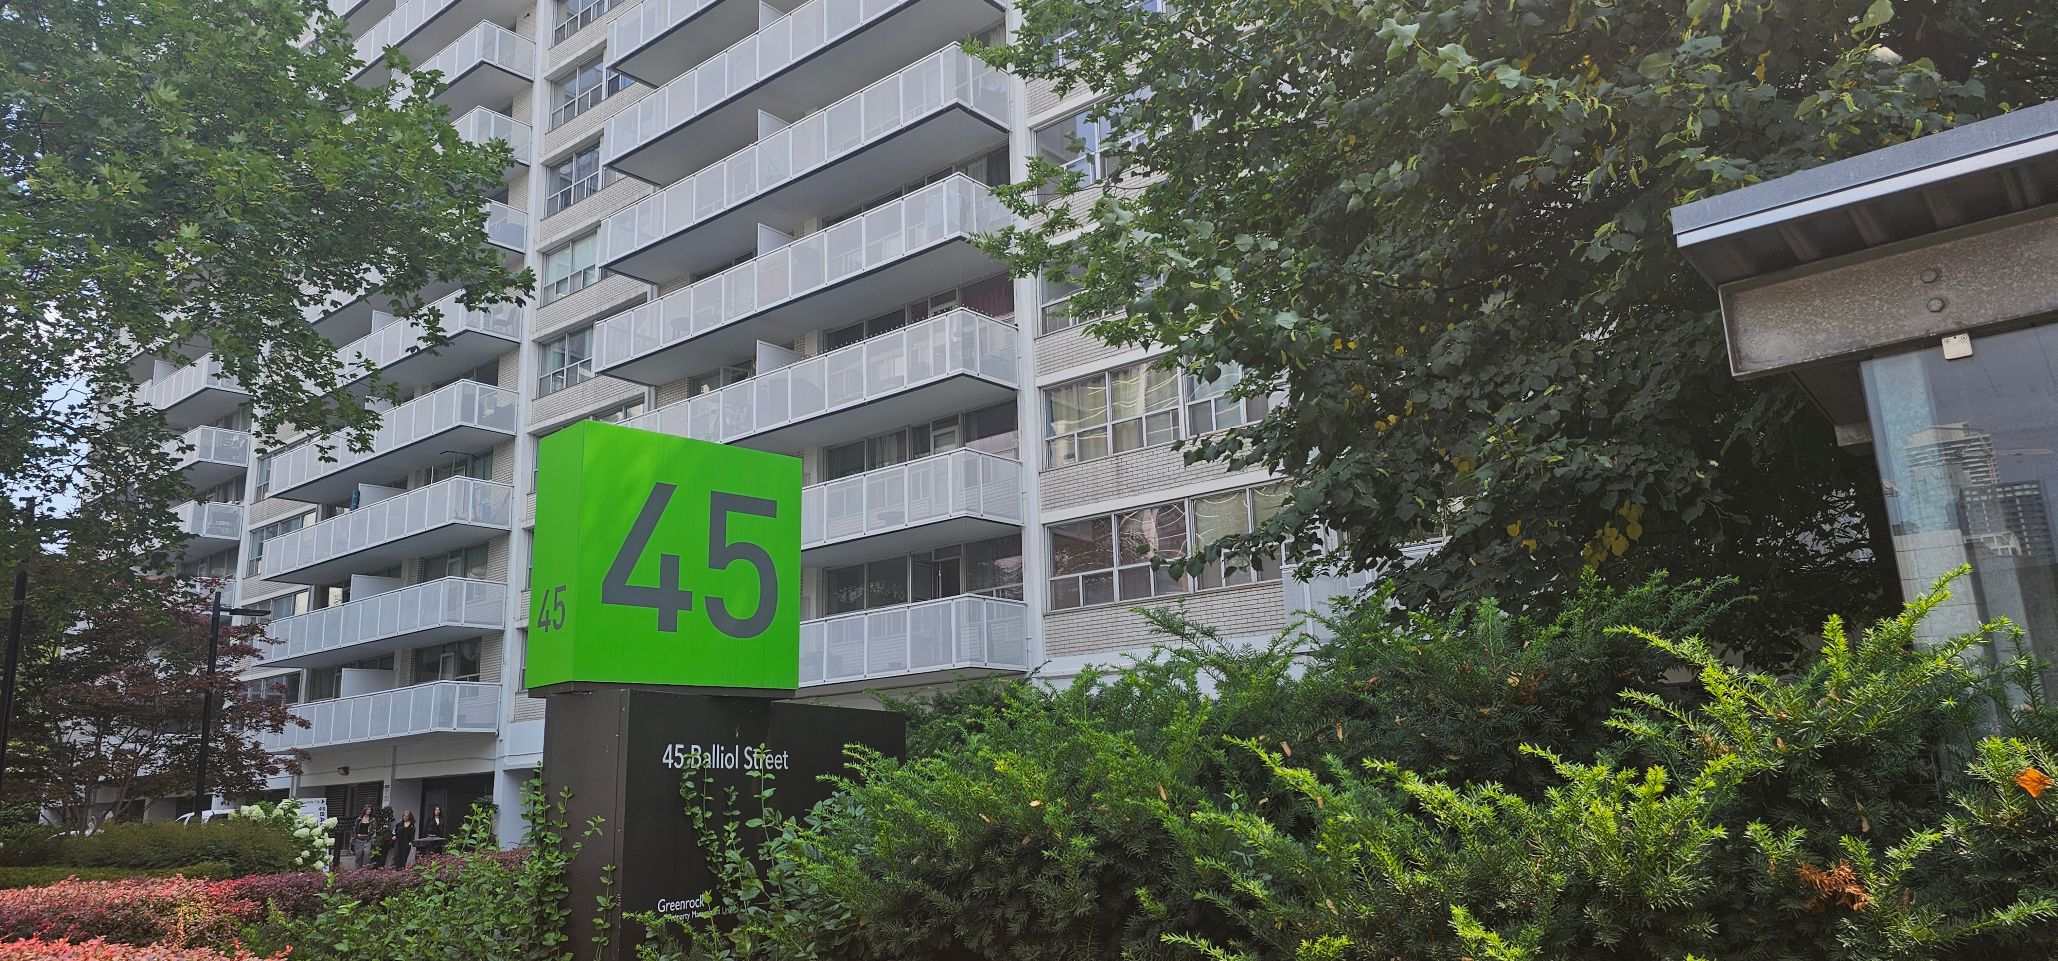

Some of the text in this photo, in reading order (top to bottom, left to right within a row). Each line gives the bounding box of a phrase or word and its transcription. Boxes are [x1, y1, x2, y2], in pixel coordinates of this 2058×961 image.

[601, 481, 779, 639] 45
[537, 584, 567, 632] 45
[662, 743, 685, 769] 45
[691, 744, 739, 769] Balliol
[657, 894, 705, 913] Greenrock
